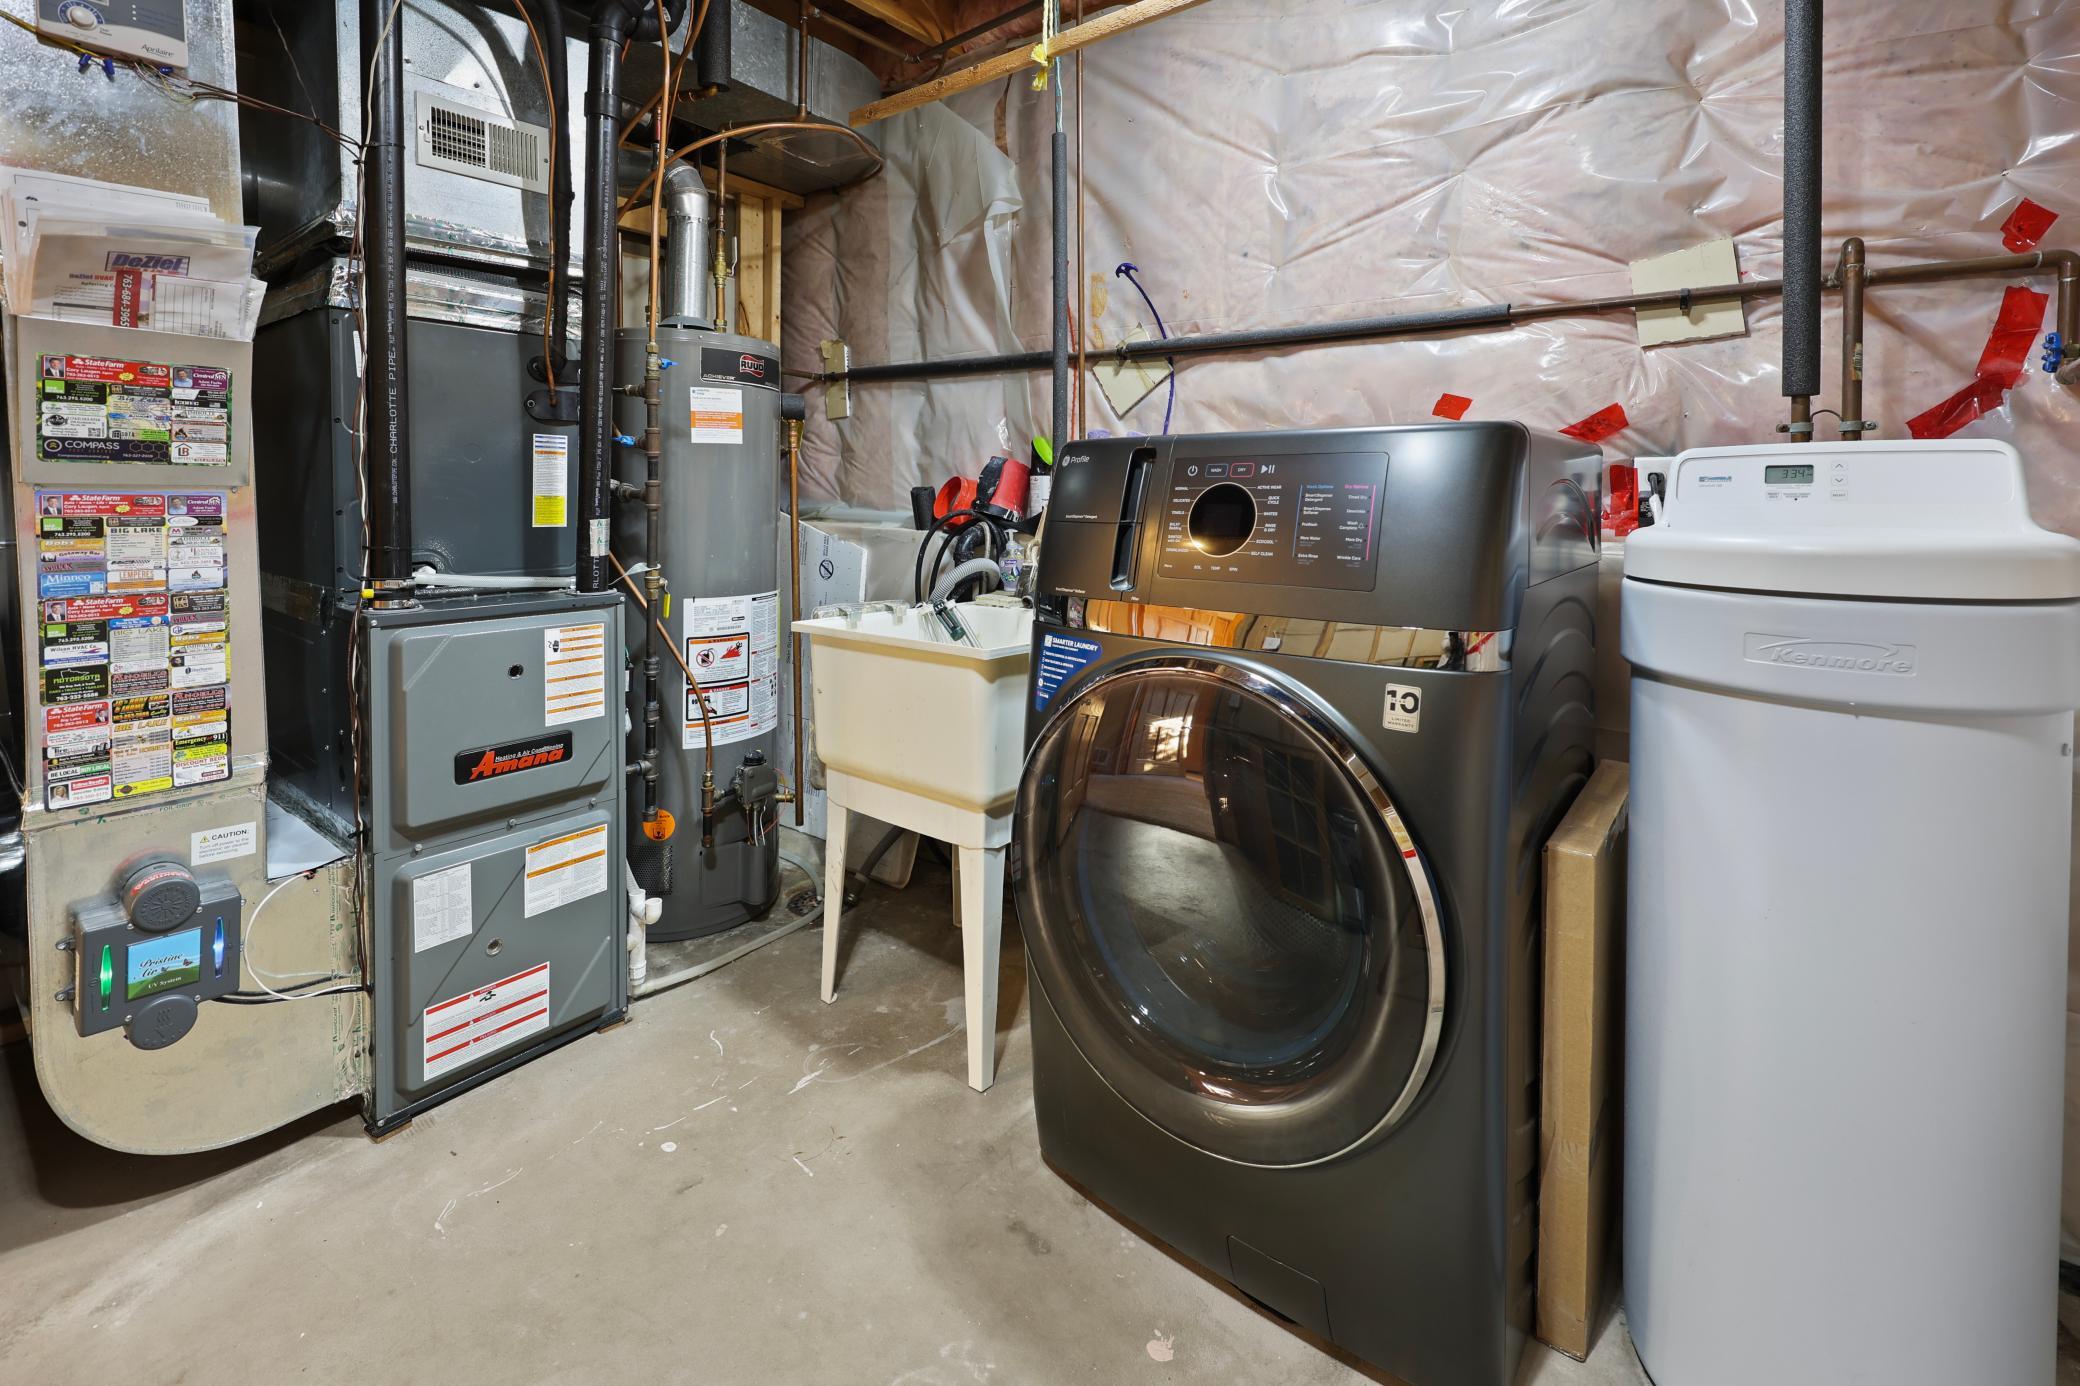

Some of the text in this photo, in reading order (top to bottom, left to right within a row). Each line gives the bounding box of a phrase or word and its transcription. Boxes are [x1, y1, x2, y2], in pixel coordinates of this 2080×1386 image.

[141, 44, 174, 58] Aprilaire
[111, 254, 183, 270] DeZiel
[120, 273, 133, 328] 763-684-3965
[388, 350, 396, 380] PIPE
[740, 360, 764, 371] RUUD
[388, 387, 397, 454] CHARLOTTE
[65, 440, 120, 450] COMPASS
[1070, 455, 1090, 464] Profile
[1052, 637, 1098, 652] SMARTER LAUNDRY
[1770, 648, 1912, 674] Kenmore
[1387, 690, 1419, 714] 10
[138, 719, 168, 728] LAKE
[176, 736, 206, 745] Emergency
[495, 752, 516, 763] Heating
[531, 743, 564, 754] Conditioning
[469, 749, 564, 781] Amana
[212, 829, 247, 841] CAUTION
[140, 952, 183, 967] Pristine
[160, 976, 182, 986] System
